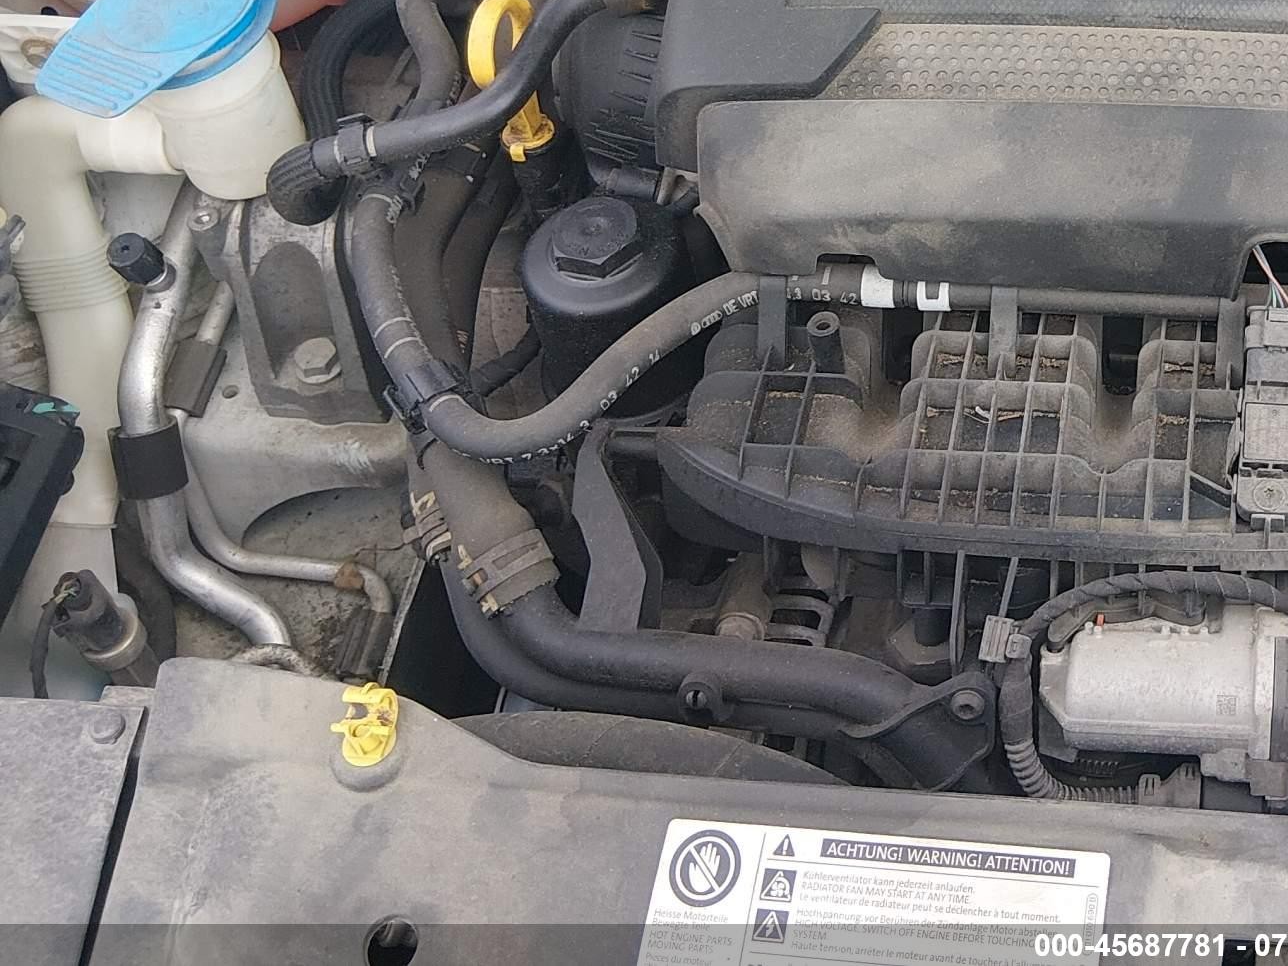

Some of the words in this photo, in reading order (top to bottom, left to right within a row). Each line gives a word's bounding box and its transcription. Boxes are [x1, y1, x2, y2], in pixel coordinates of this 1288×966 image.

[811, 288, 831, 302] 03
[840, 291, 858, 305] 42
[826, 842, 902, 861] ACHTUNG!
[907, 848, 982, 868] WARNING!
[985, 855, 1070, 875] ATTENTION!
[802, 882, 844, 894] RADIATOR
[846, 886, 863, 896] FAN
[865, 888, 885, 897] MAY
[887, 889, 913, 899] START
[914, 891, 926, 900] AT
[927, 892, 946, 902] ANY
[873, 877, 894, 887] kann
[896, 879, 933, 892] jederzeit
[860, 898, 871, 907] de
[871, 898, 910, 911] radiateur
[912, 903, 933, 914] peut
[1001, 910, 1019, 920] tout
[917, 929, 950, 941] ENGINE
[952, 932, 985, 944] BEFORE
